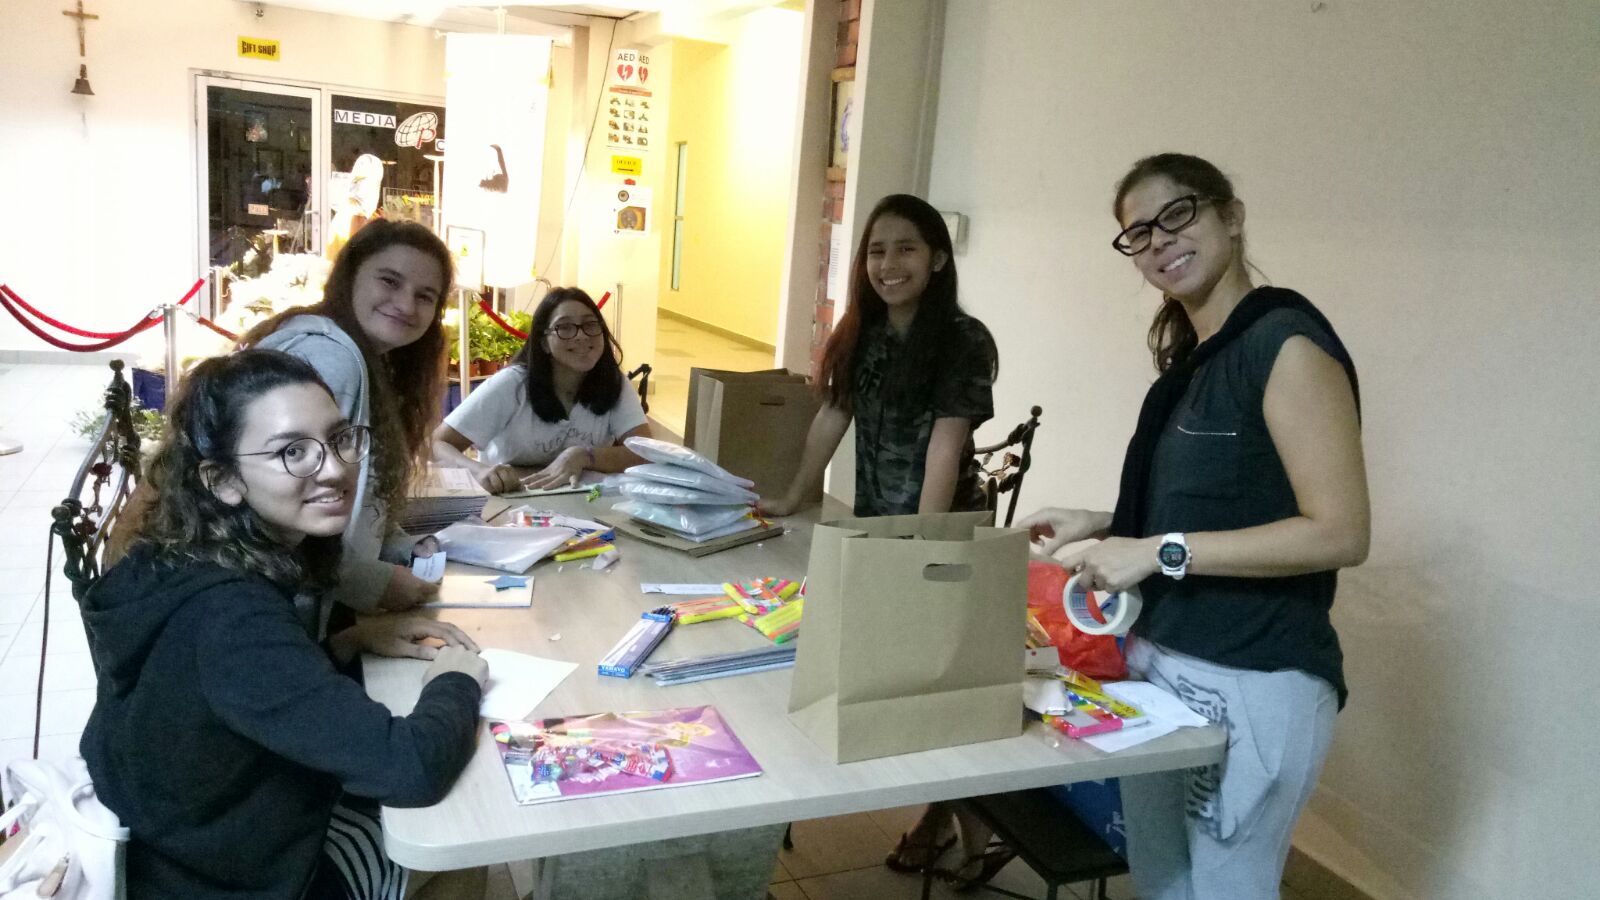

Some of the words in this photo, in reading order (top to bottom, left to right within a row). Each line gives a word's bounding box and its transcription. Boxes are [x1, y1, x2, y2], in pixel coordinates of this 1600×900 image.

[241, 40, 256, 54] GIFT
[257, 44, 276, 57] SHOP
[617, 53, 635, 61] AED
[639, 55, 649, 65] AED
[335, 110, 395, 128] MEDIA
